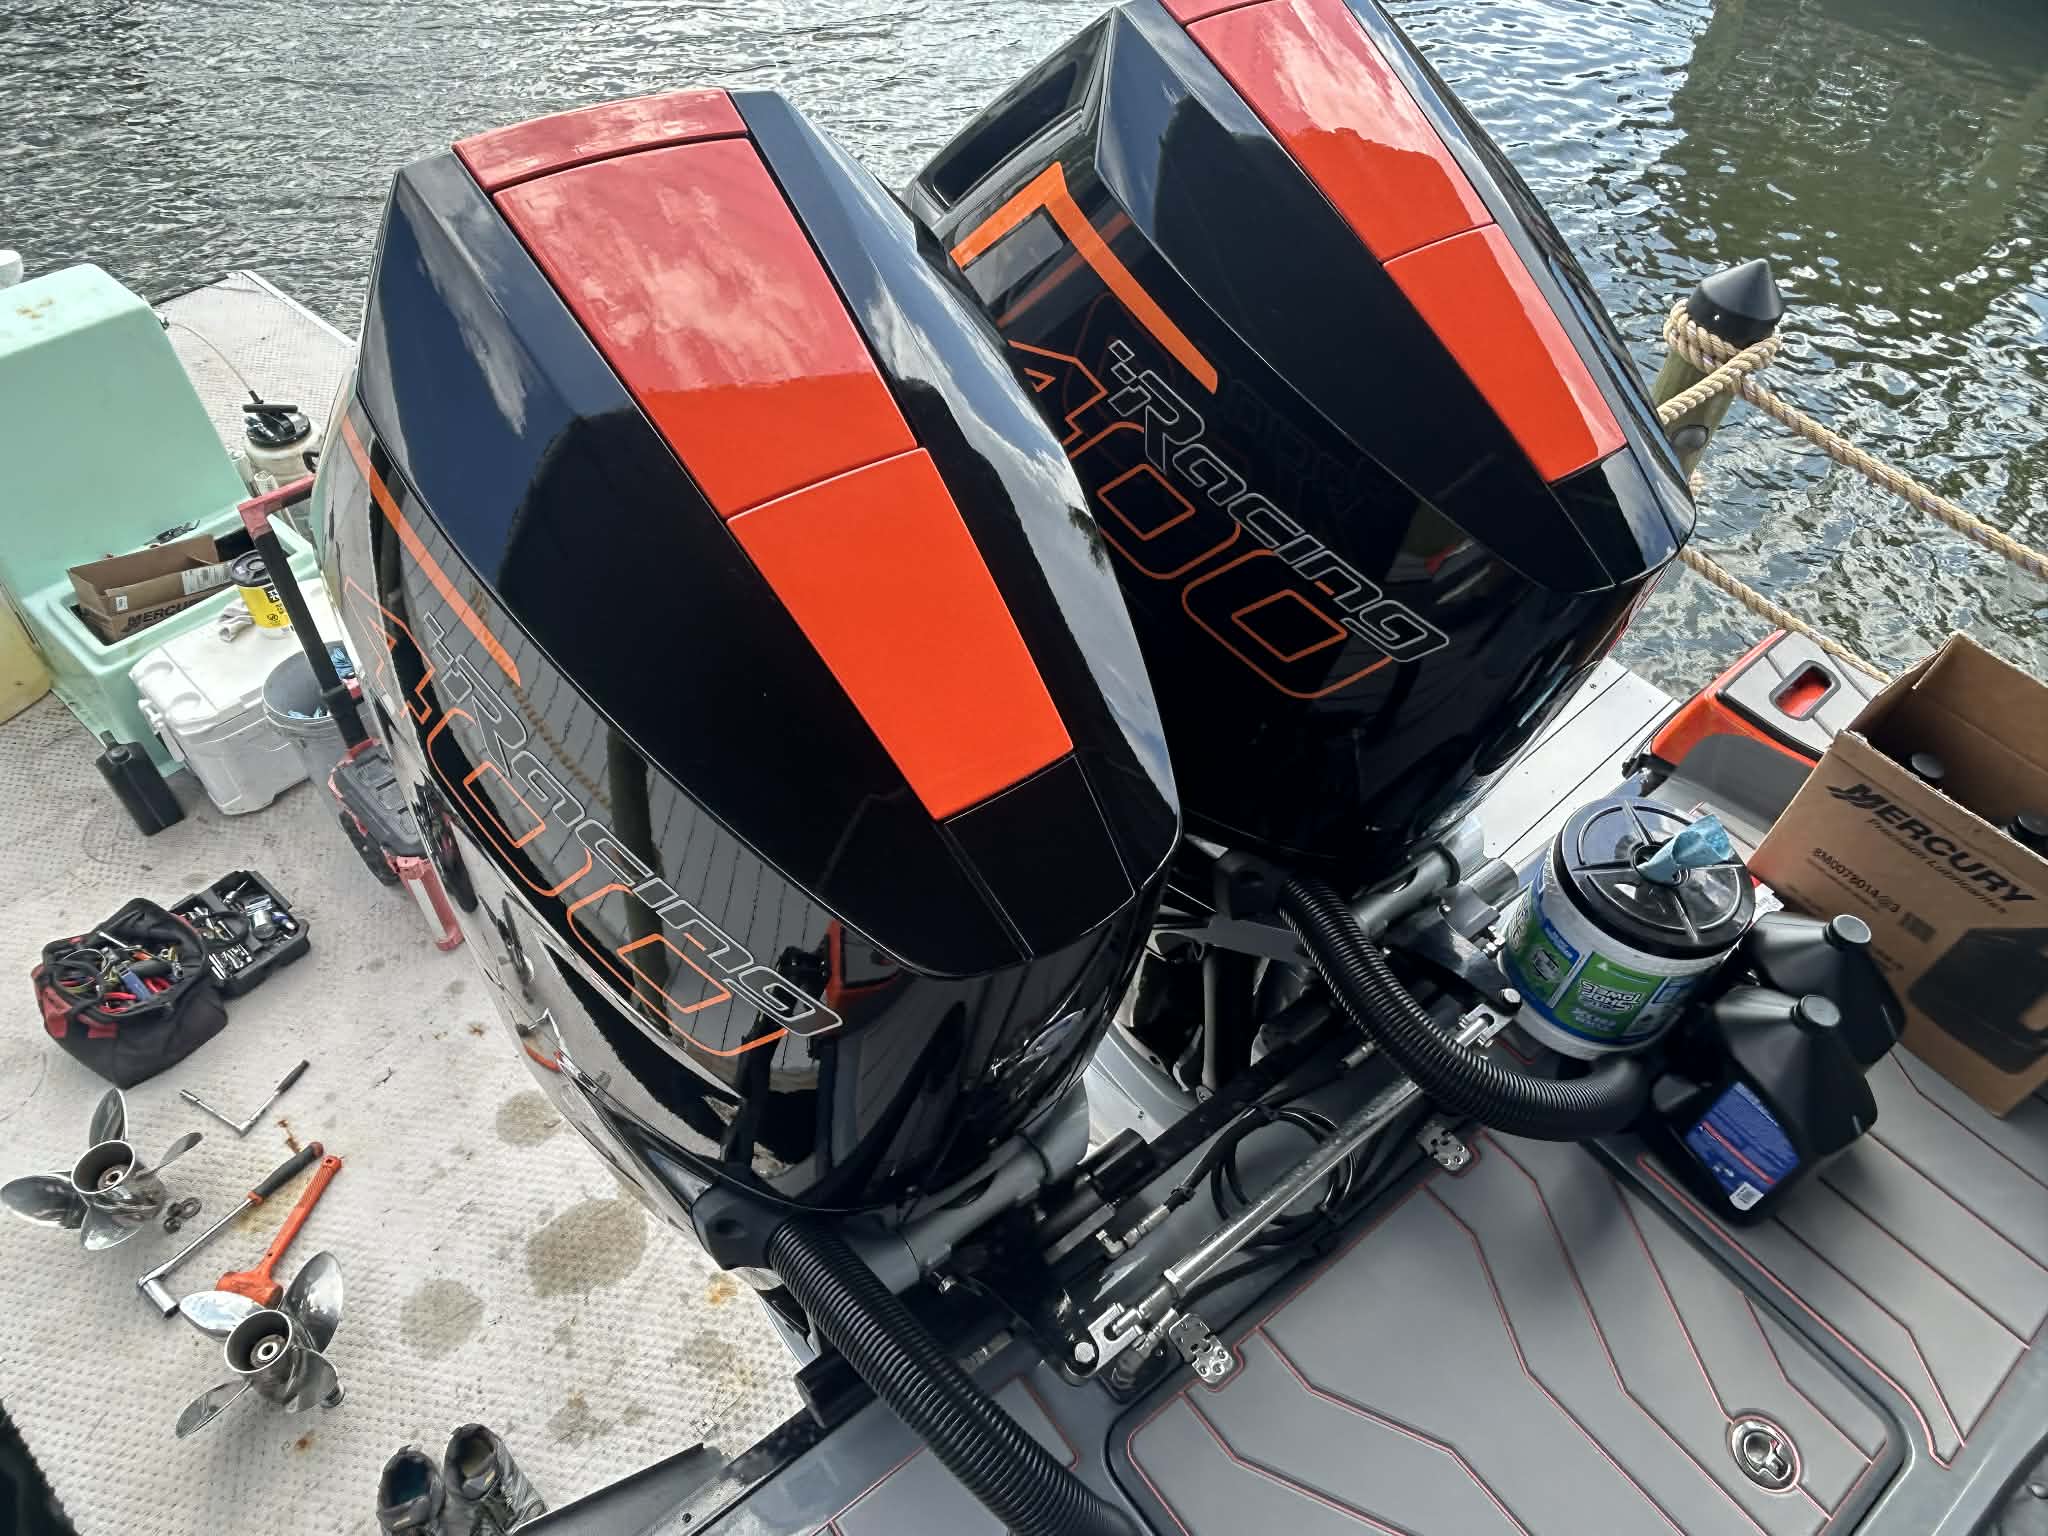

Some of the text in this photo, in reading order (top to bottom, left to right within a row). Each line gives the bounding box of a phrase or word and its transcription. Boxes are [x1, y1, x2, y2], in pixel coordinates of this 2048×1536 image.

[1107, 369, 1450, 663] Racing
[436, 650, 843, 1037] Racing
[1825, 783, 2037, 901] MERCURY
